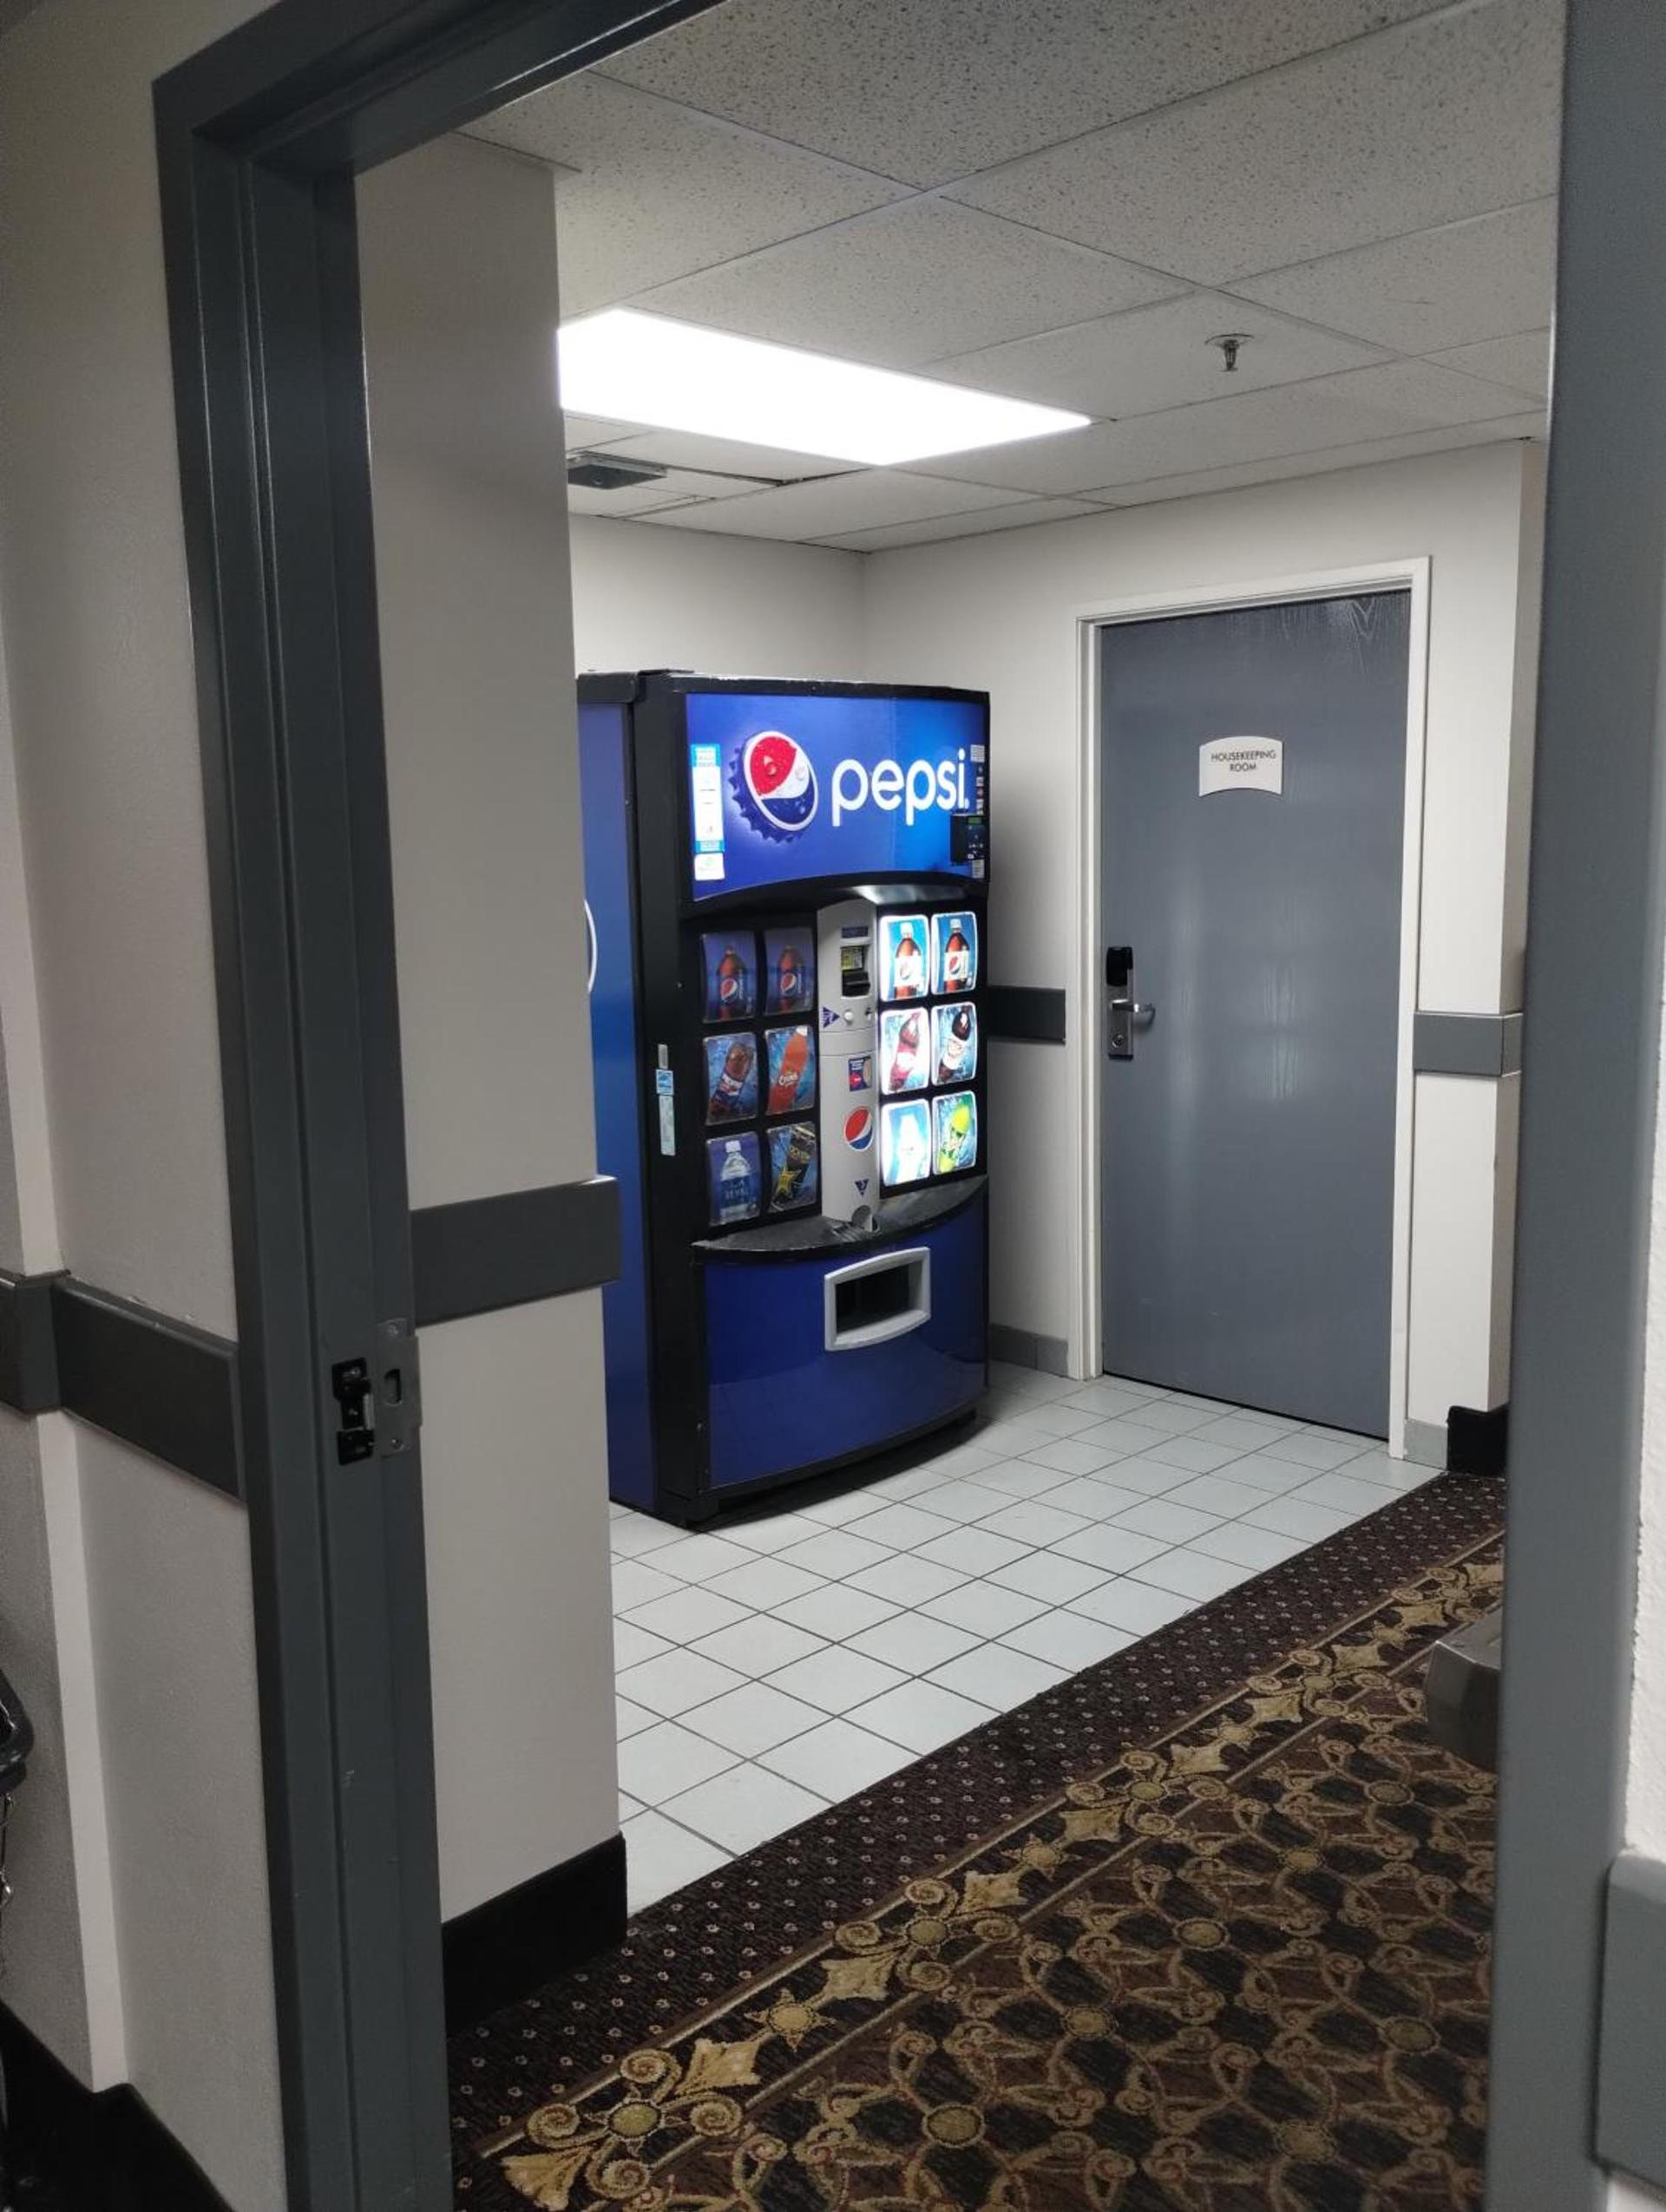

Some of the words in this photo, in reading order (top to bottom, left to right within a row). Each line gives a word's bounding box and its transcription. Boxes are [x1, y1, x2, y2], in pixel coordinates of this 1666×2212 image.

[1211, 749, 1276, 761] HOUSEKEEPING
[1230, 763, 1256, 772] ROOM
[832, 749, 967, 827] pepsi
